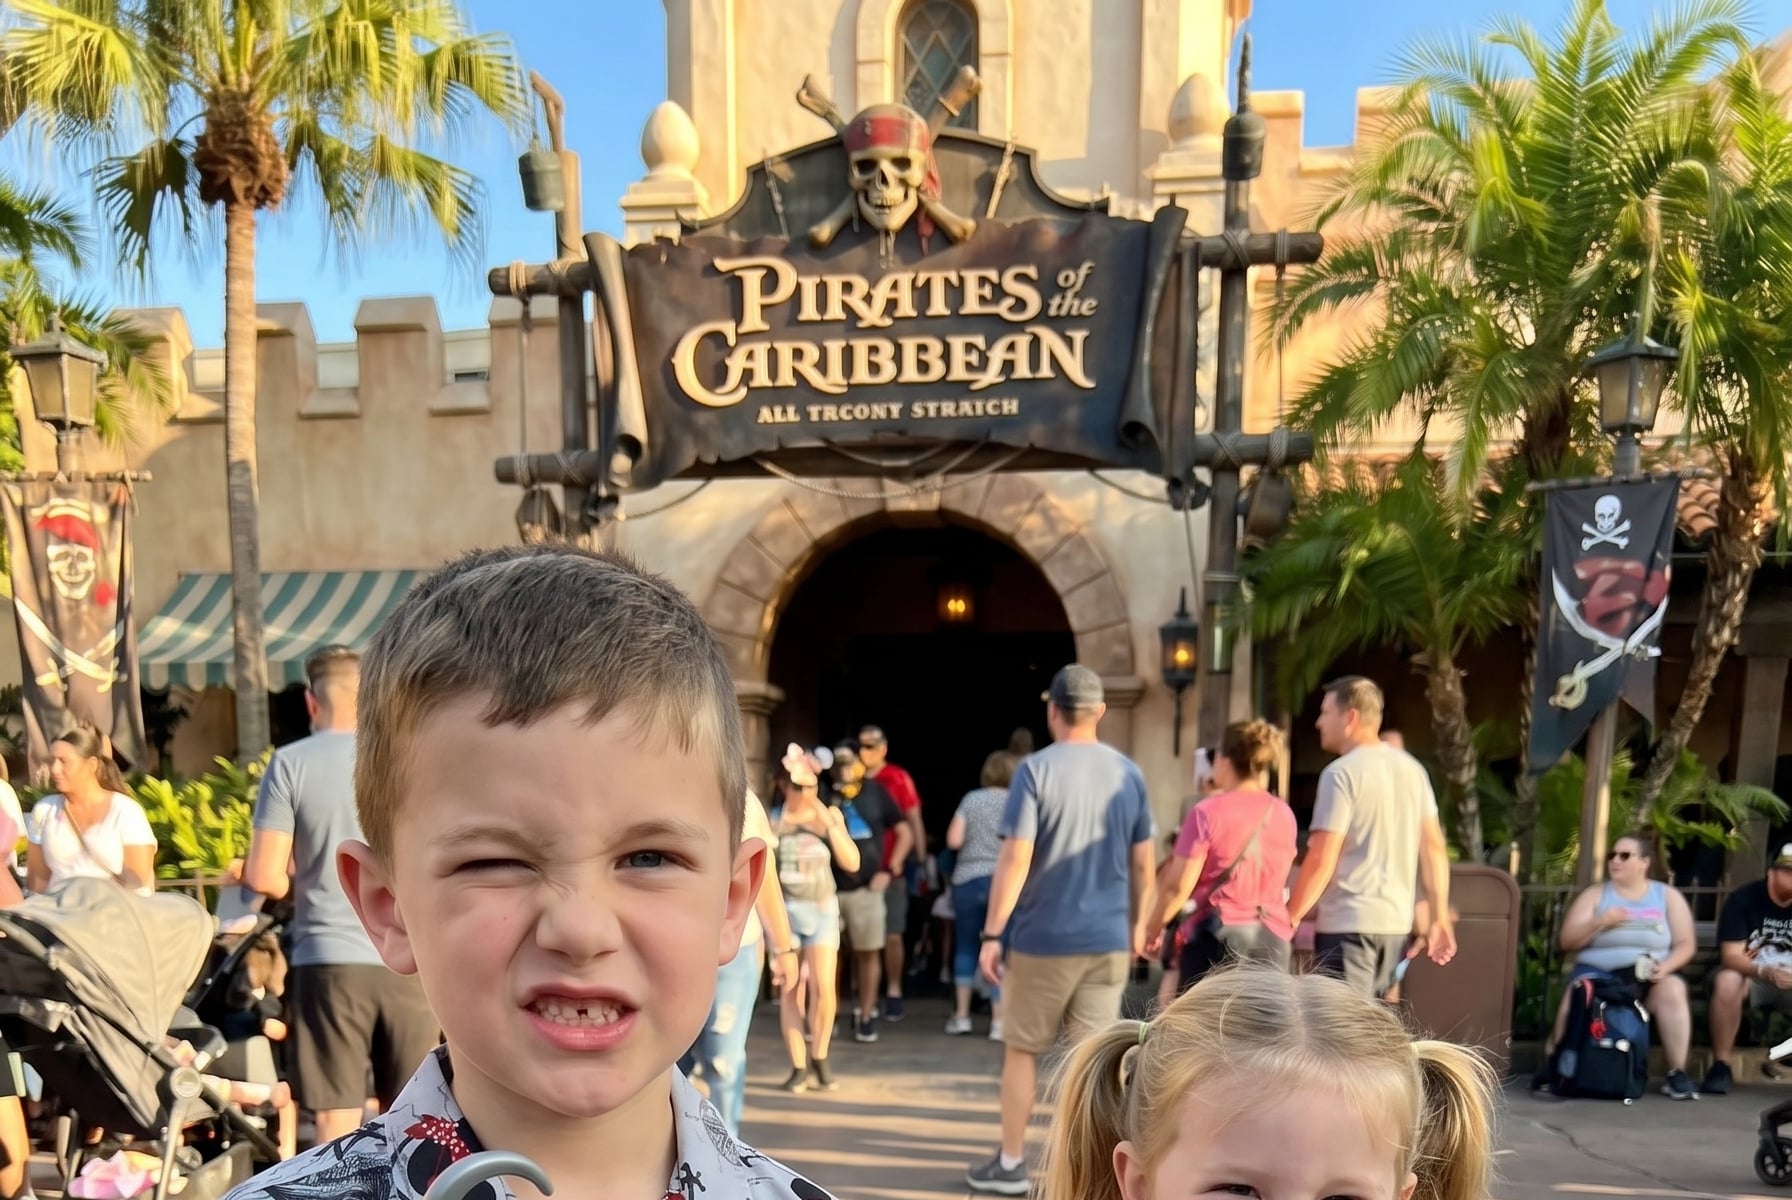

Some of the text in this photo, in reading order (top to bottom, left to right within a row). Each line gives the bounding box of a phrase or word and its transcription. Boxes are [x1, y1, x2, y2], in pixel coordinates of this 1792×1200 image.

[713, 256, 1095, 335] PIRATES of
[1047, 289, 1098, 318] the
[671, 324, 1097, 408] CARIBBEAN
[757, 404, 800, 424] ALL
